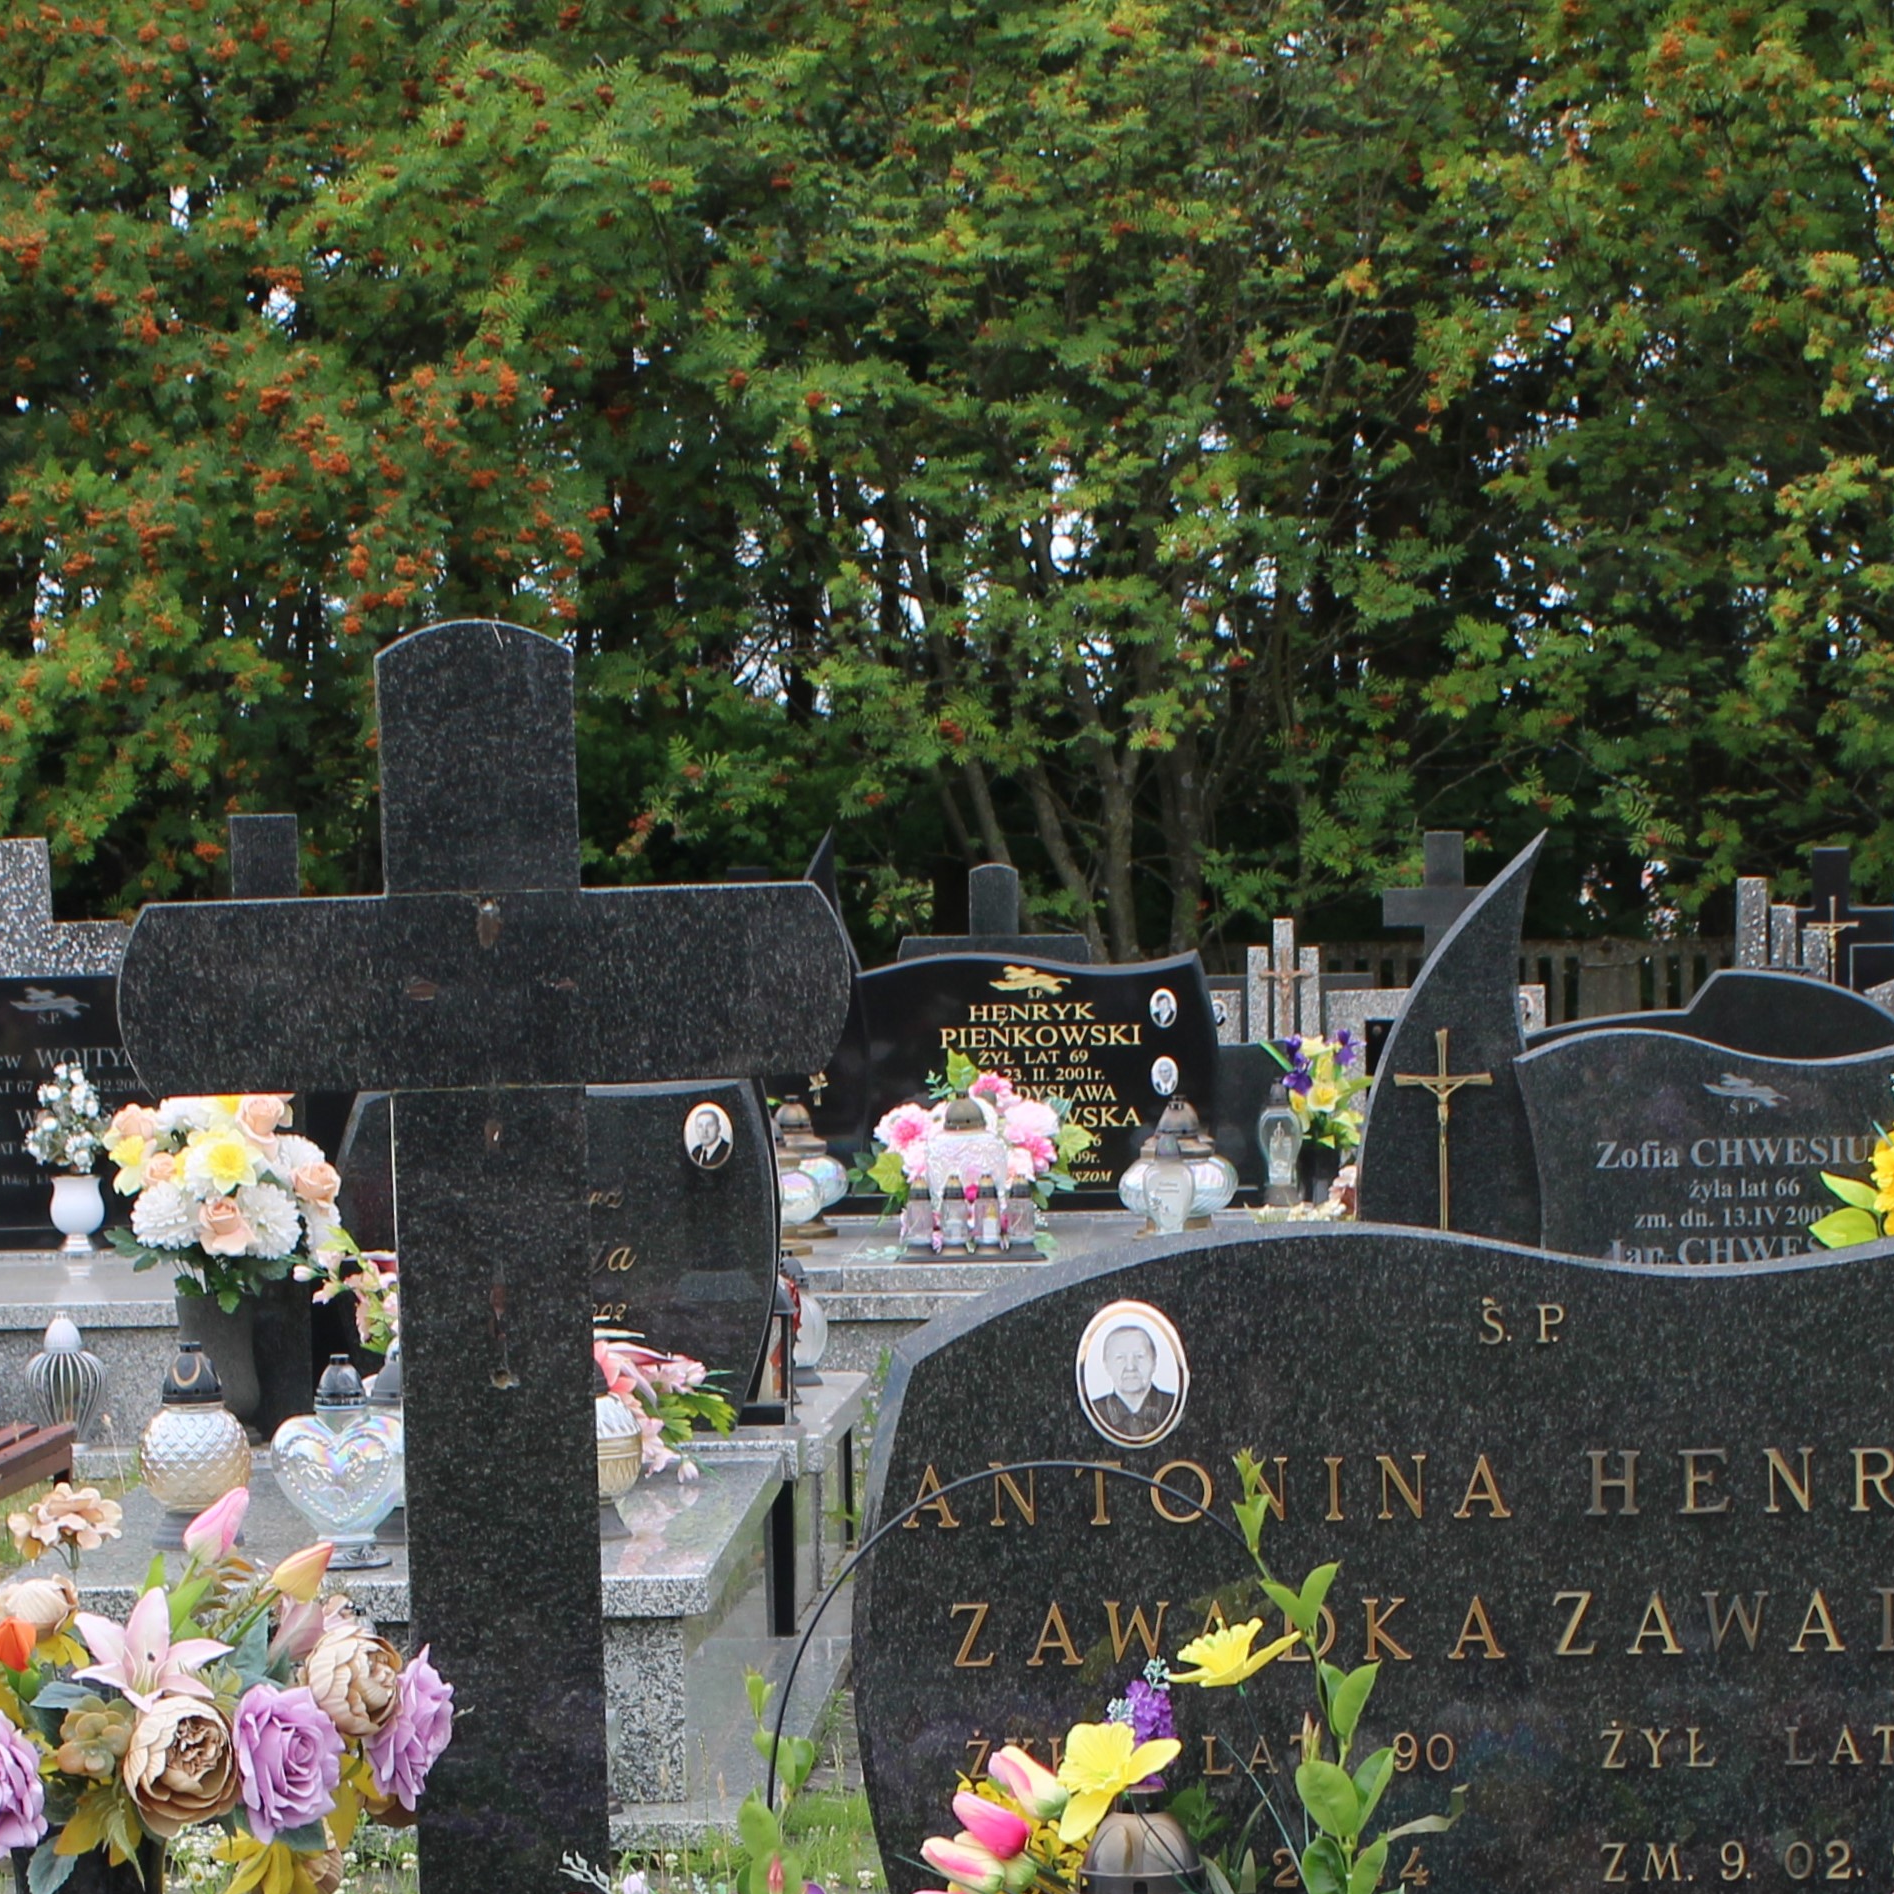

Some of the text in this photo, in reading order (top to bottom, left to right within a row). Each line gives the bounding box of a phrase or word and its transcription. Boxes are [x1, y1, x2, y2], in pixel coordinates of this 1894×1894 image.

[969, 1003, 1095, 1022] HENRYK
[940, 1021, 1142, 1049] PIEŃKOWSKI
[978, 1049, 1089, 1066] ŻYŁ LAT 69
[1033, 1068, 1051, 1081] II.
[1055, 1067, 1105, 1081] 2001r.
[17, 1081, 33, 1093] 67
[1016, 1085, 1118, 1102] DYSŁAWA
[1596, 1136, 1871, 1169] Zofia CHWESIU
[1740, 1178, 1768, 1197] lat
[1775, 1176, 1801, 1197] 66
[1634, 1211, 1673, 1229] zm.
[1679, 1207, 1715, 1228] dn.
[1722, 1206, 1782, 1227] 13.IV
[902, 1454, 1512, 1529] ANTONINA
[949, 1595, 1506, 1668] ZAWDKA
[1393, 1732, 1457, 1773] 90
[1601, 1720, 1716, 1769] ŻYŁ
